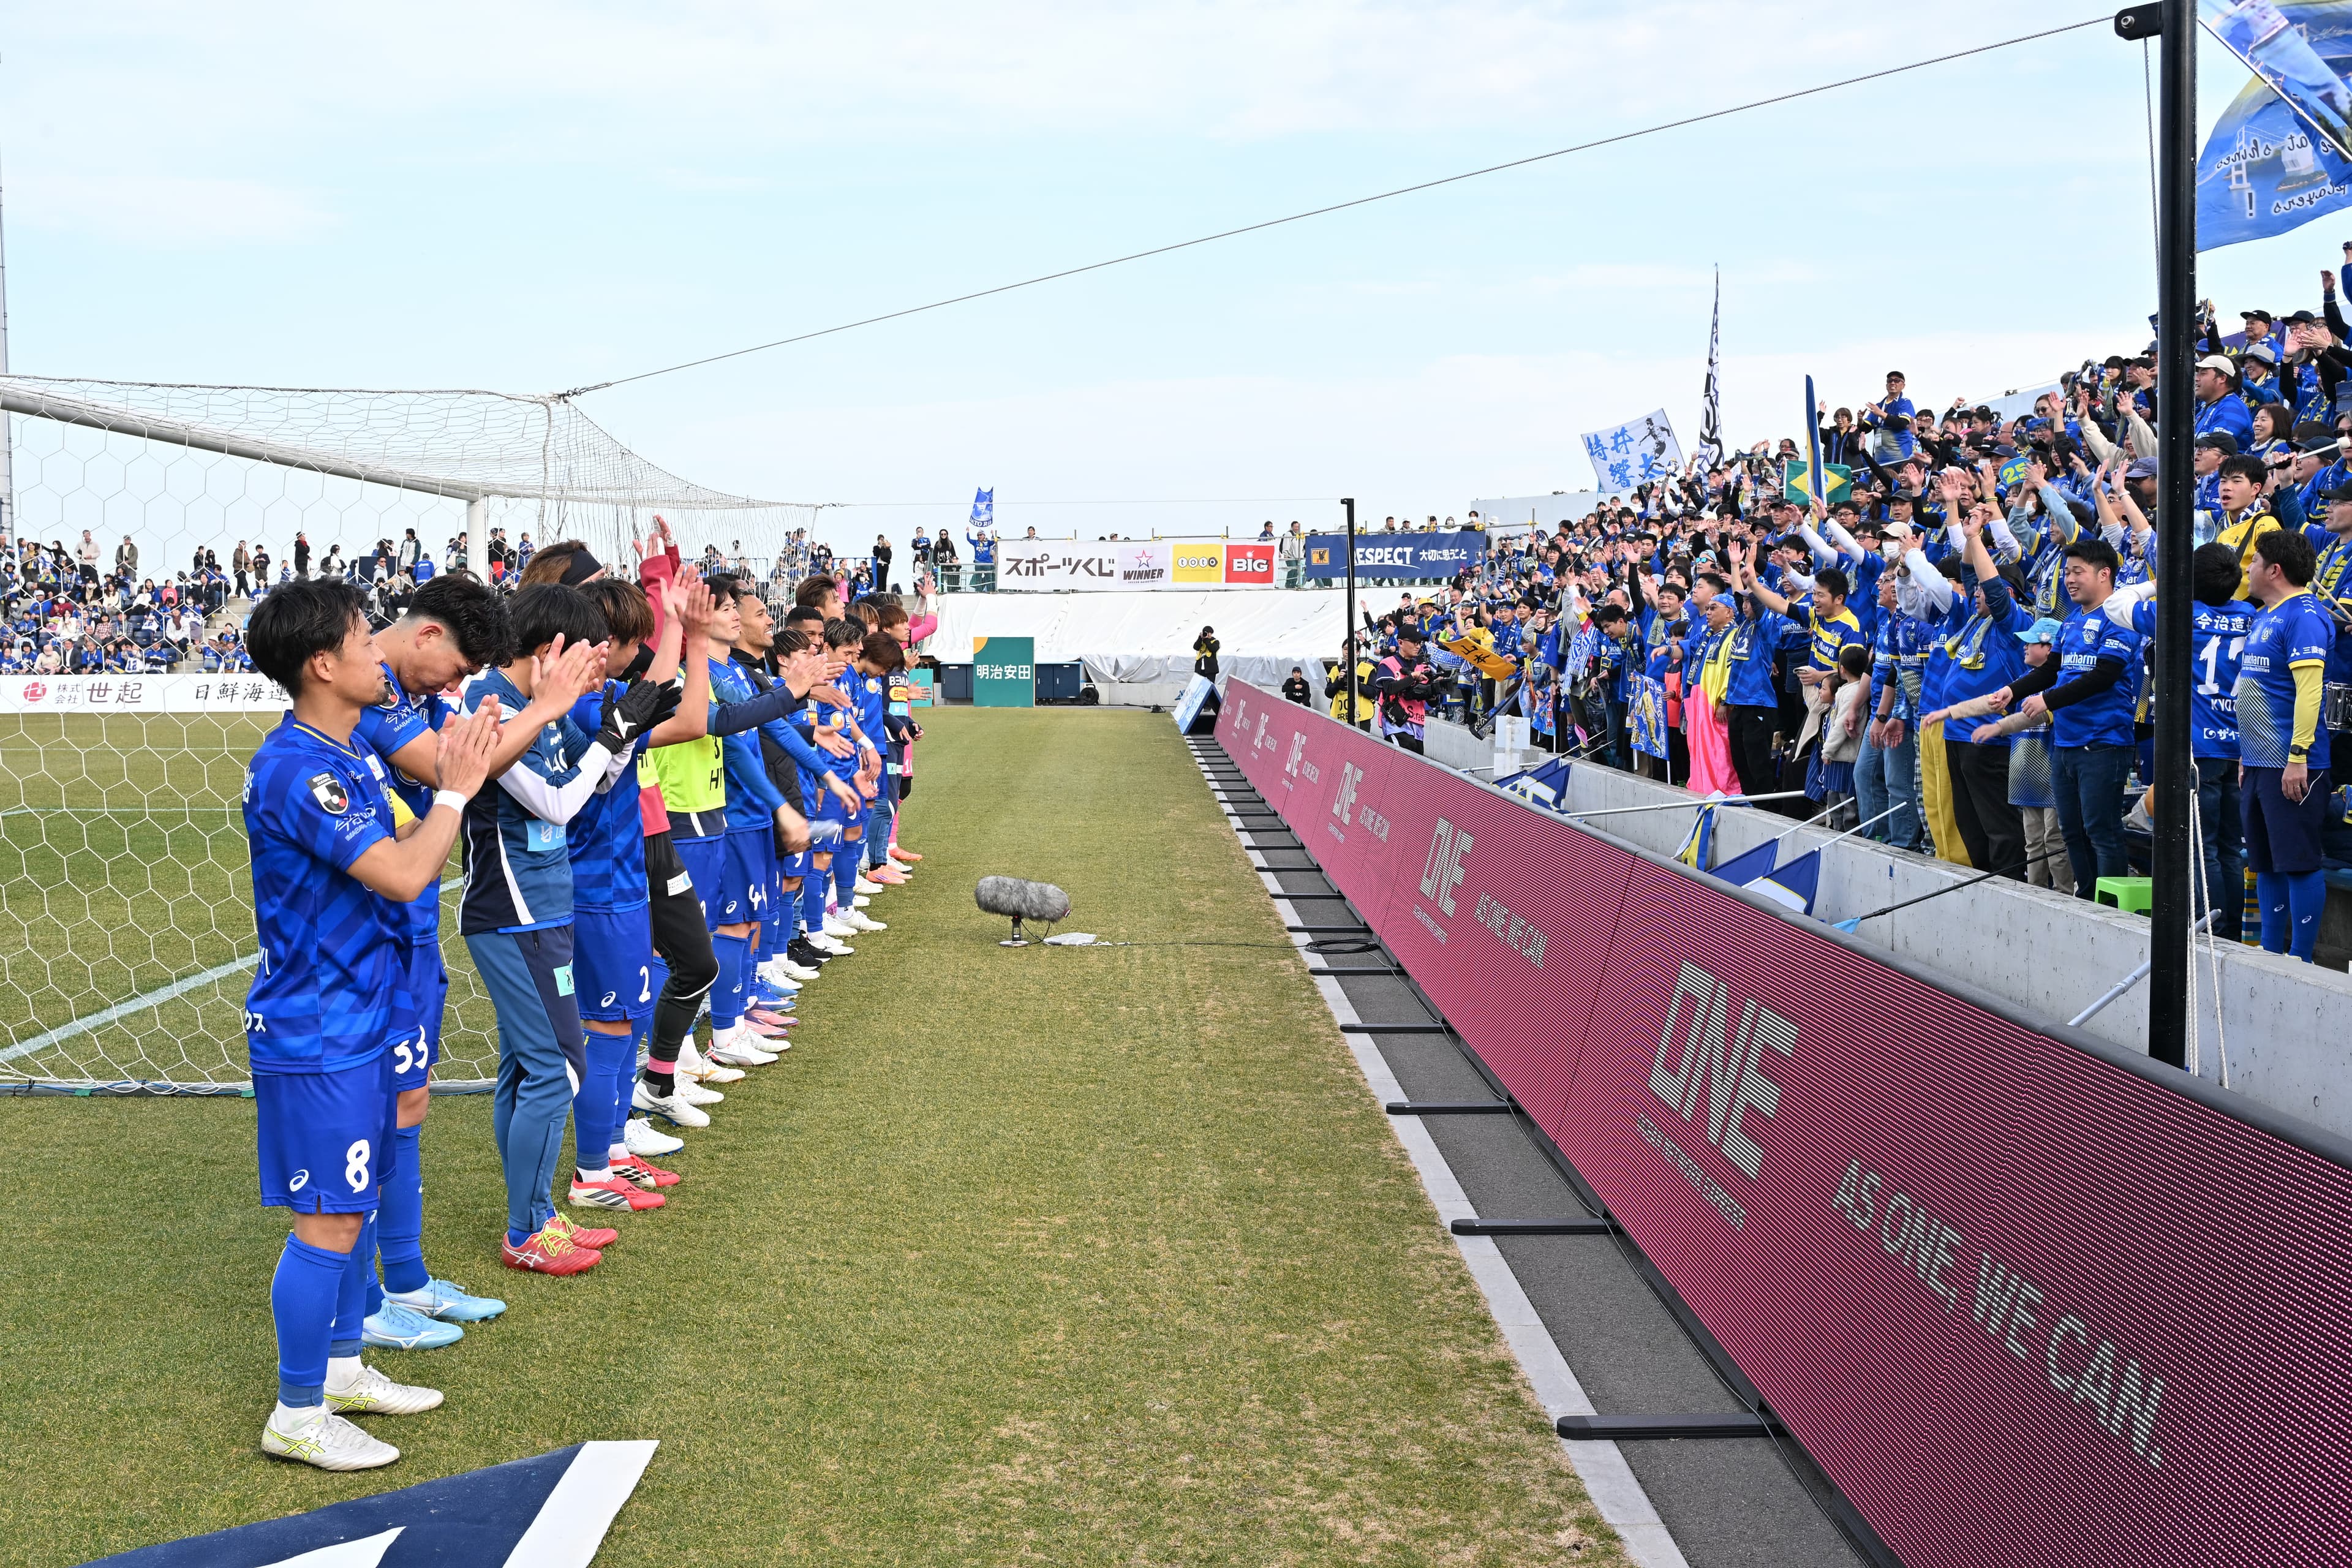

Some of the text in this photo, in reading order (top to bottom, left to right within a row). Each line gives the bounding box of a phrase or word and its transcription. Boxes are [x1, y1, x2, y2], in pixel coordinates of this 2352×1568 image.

[1177, 557, 1218, 568] toto
[1419, 549, 1468, 562] 大切に思うこと
[1005, 553, 1115, 577] スポーツくじ
[1232, 557, 1270, 573] BIG
[1123, 568, 1164, 581] WINNER
[976, 665, 1031, 680] 明治安田
[57, 683, 81, 693] 株式
[86, 682, 142, 704] 世起
[55, 695, 78, 704] 会社
[2217, 727, 2239, 741] ザイ
[1419, 816, 1475, 919] ONE
[1648, 959, 1800, 1181] ONE
[345, 1139, 370, 1194] 8
[1832, 1158, 1882, 1231] AS
[1973, 1252, 2043, 1360] WE
